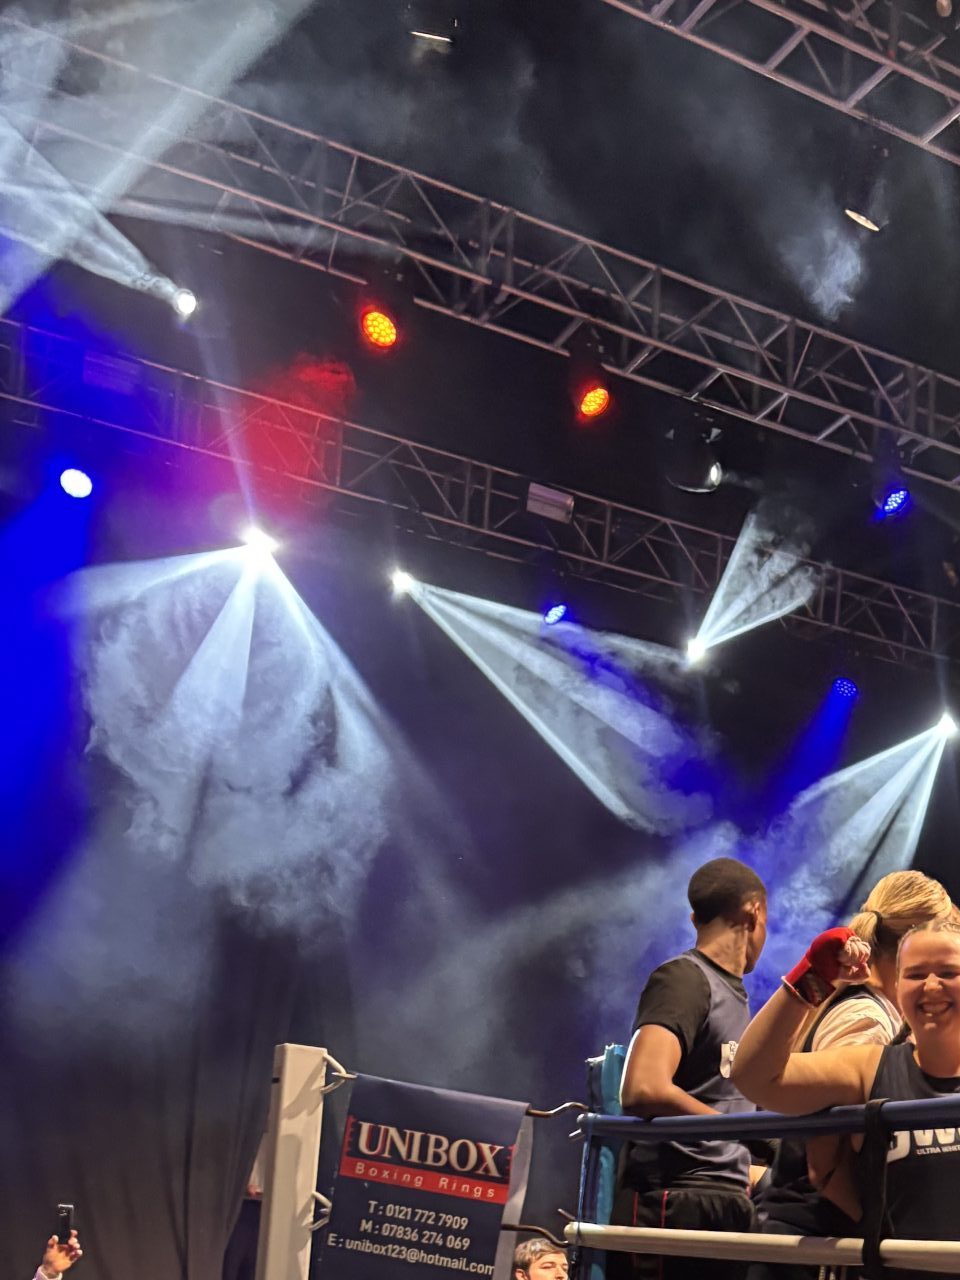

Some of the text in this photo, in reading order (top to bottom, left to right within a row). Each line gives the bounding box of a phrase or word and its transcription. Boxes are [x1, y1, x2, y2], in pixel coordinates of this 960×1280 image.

[357, 1121, 505, 1177] UNIBOX
[916, 1145, 941, 1155] ULTRA
[354, 1162, 496, 1200] Boxing Rings
[385, 1203, 413, 1221] 0121
[414, 1208, 435, 1225] 772
[438, 1211, 469, 1230] 7909
[382, 1223, 419, 1242] 07836
[421, 1229, 444, 1246] 274
[446, 1234, 471, 1251] 069
[345, 1236, 495, 1276] unibox123@hotmail.com
